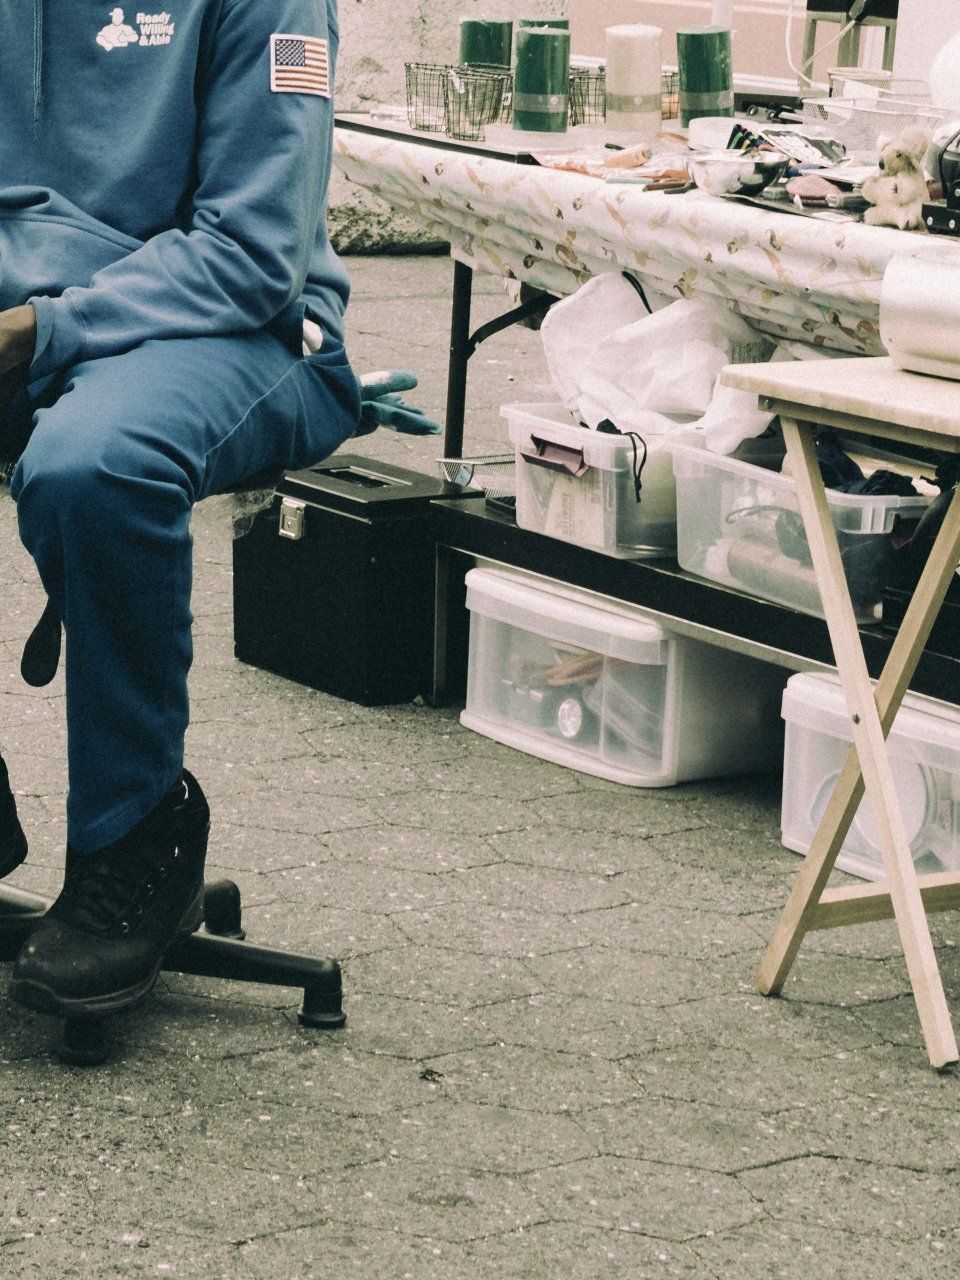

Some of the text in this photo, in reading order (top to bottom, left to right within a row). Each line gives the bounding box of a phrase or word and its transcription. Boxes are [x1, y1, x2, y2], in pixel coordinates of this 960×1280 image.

[136, 12, 171, 24] Ready
[140, 23, 175, 36] Willing
[139, 34, 171, 46] & Able
